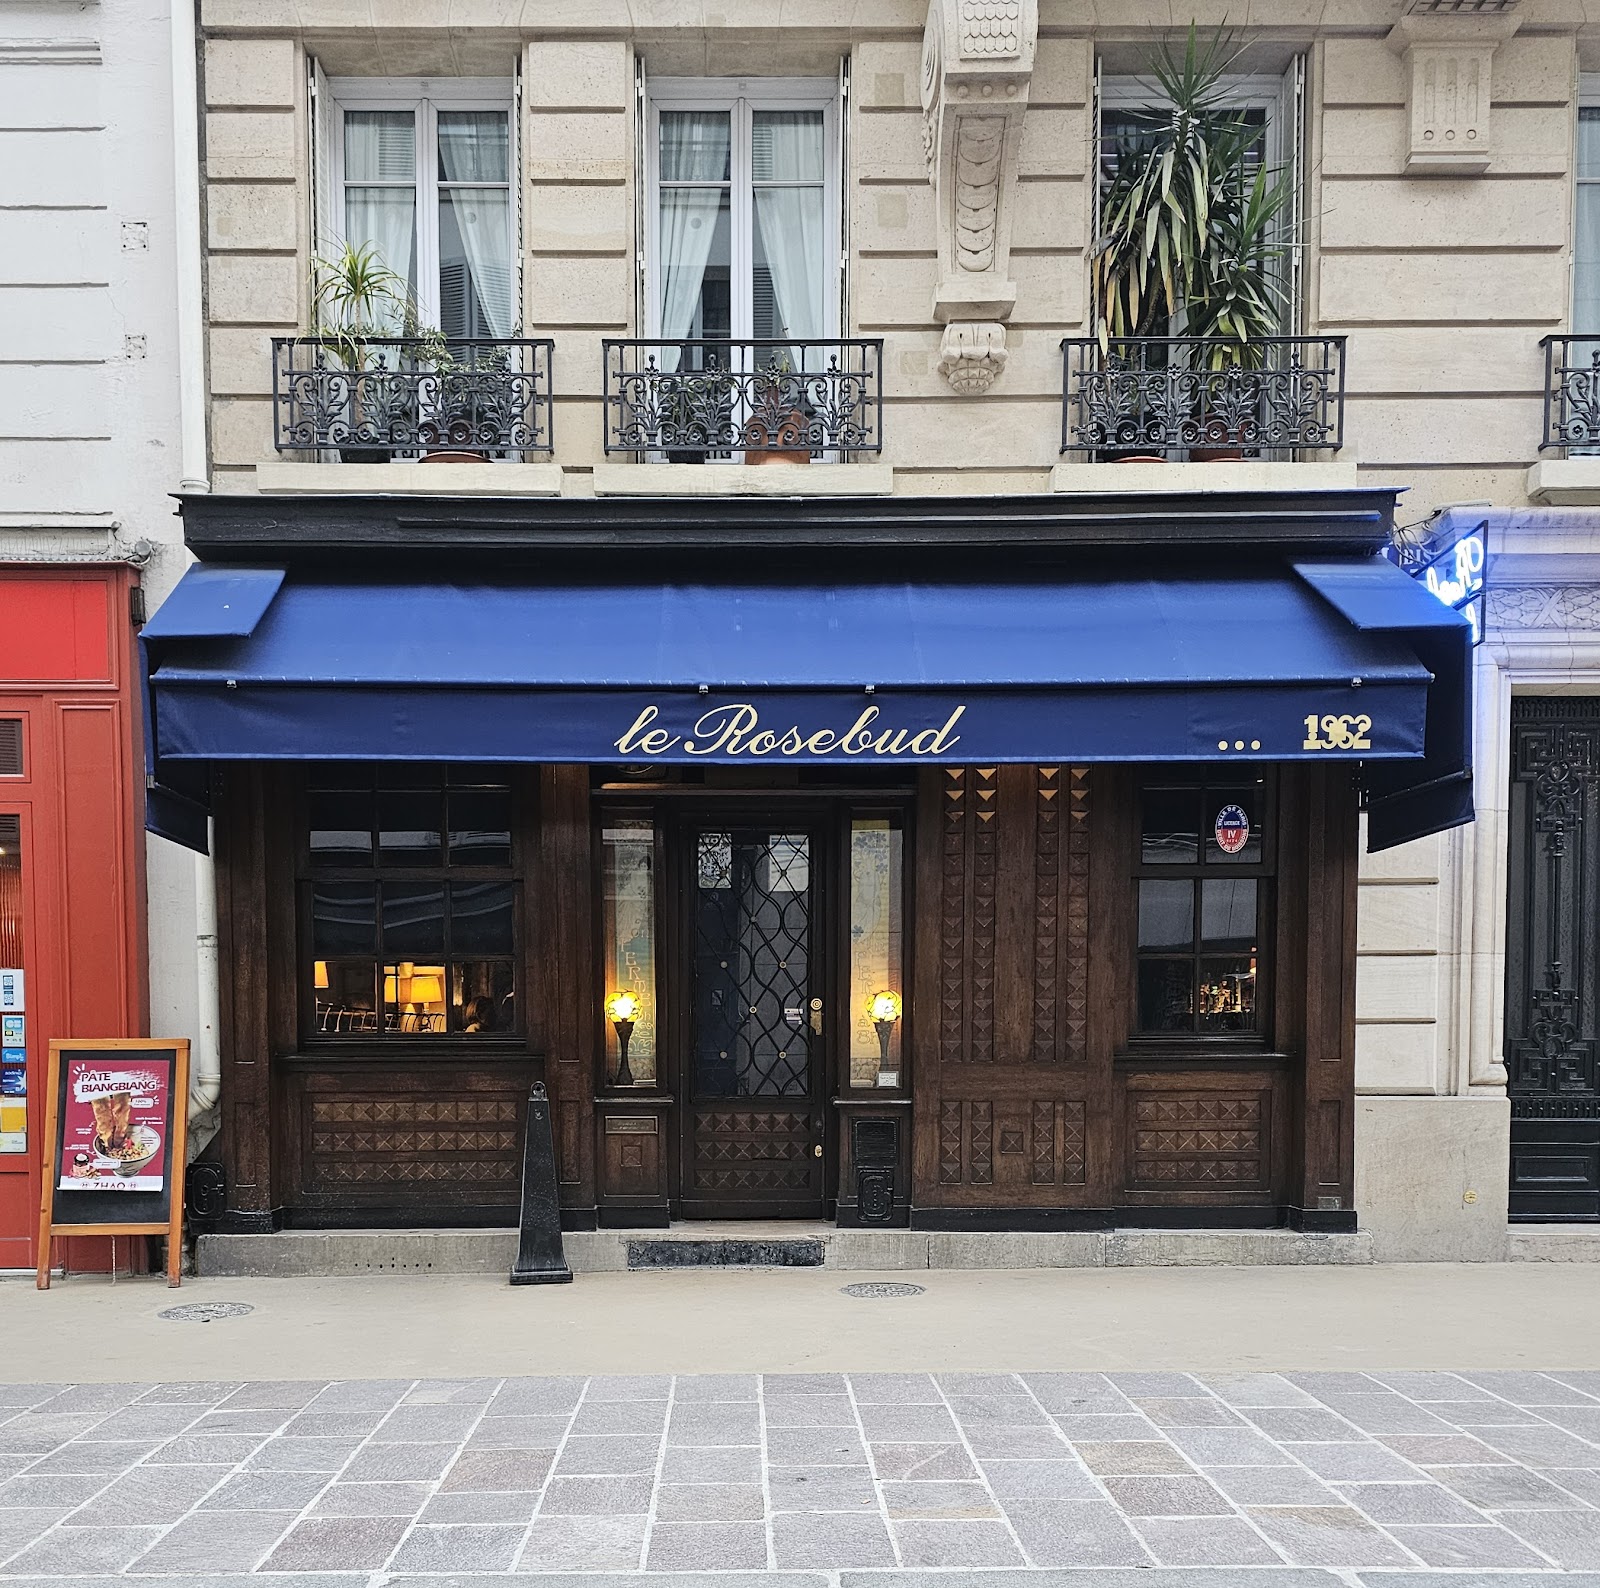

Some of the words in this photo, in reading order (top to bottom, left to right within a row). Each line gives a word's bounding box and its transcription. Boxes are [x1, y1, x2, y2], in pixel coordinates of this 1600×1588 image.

[614, 705, 681, 755] le
[684, 703, 966, 756] Rosebud
[1303, 714, 1372, 750] 1962
[1227, 829, 1236, 839] IV
[81, 1081, 156, 1093] BIANGBIANG
